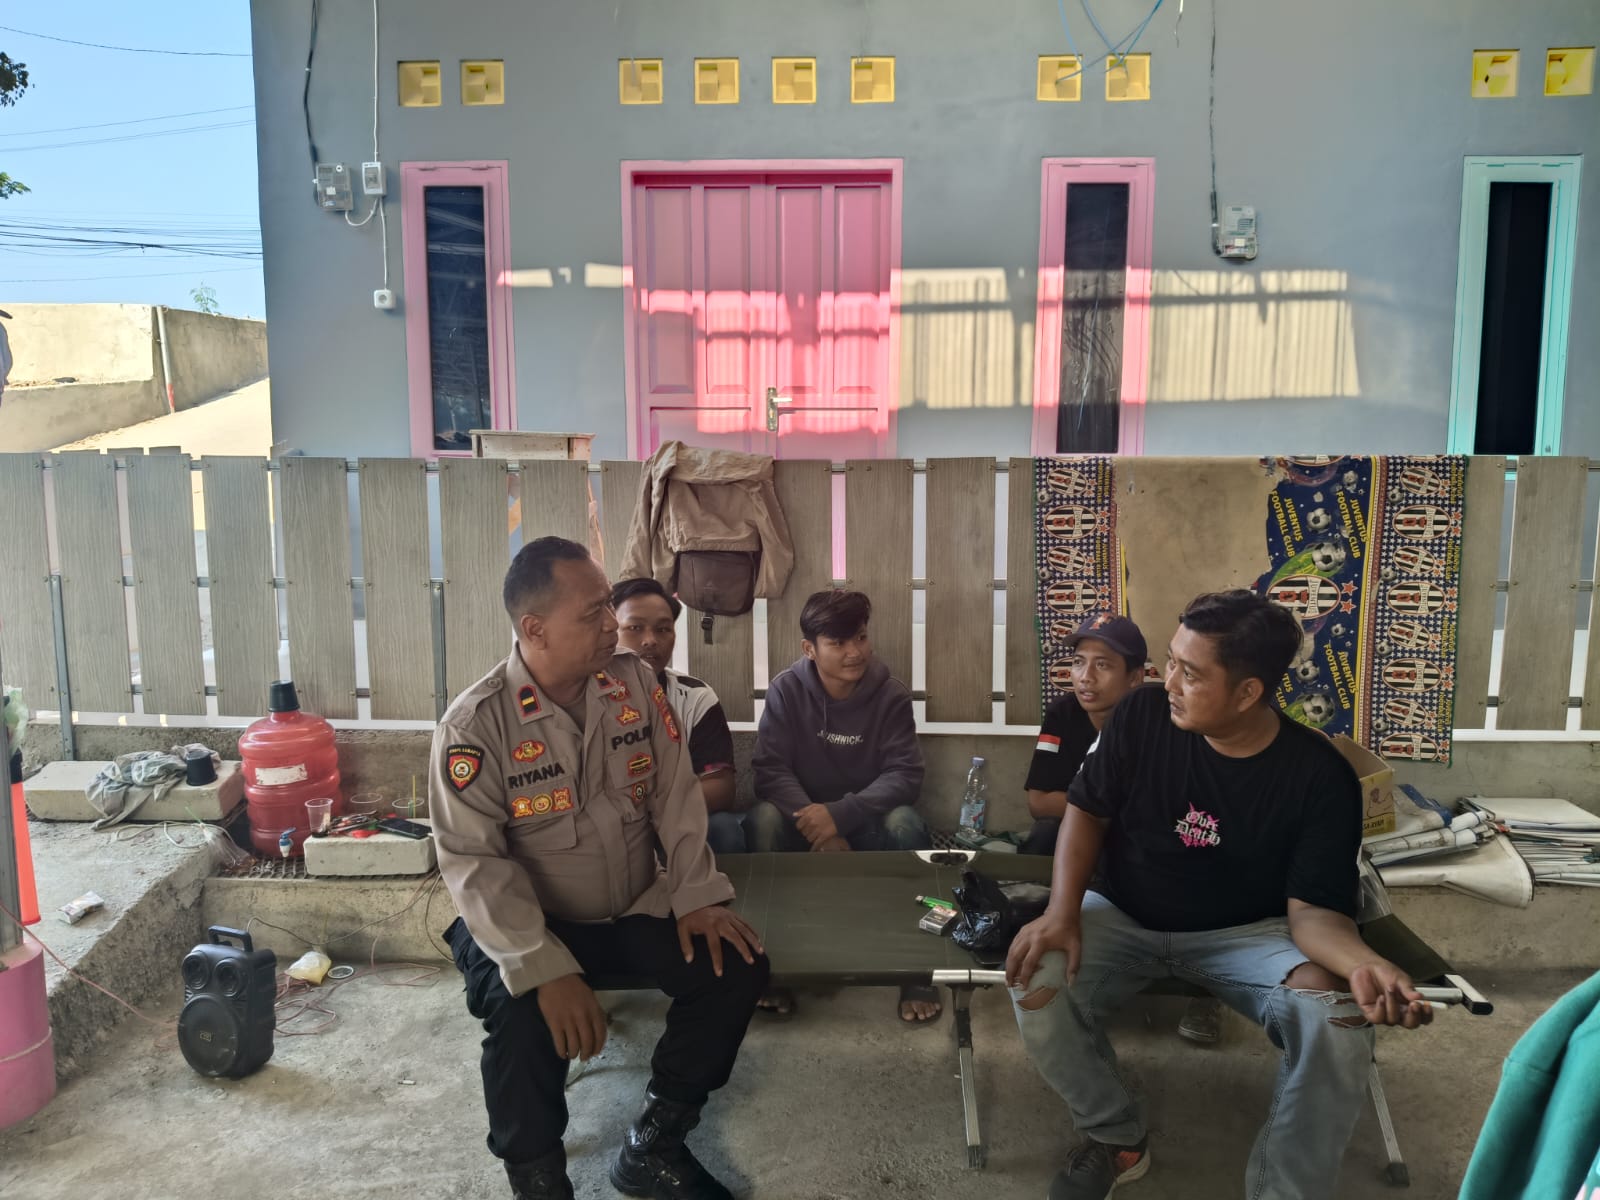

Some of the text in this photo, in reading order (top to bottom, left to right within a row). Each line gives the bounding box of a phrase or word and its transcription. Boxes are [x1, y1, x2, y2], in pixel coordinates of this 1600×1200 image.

[1271, 490, 1296, 558] FOOTBALL CLUB
[1284, 498, 1303, 541] JUVENTUS
[1336, 491, 1361, 559] FOOTBALL CLUB
[1350, 499, 1368, 543] JUVENTUS
[1323, 644, 1351, 709] FOOTBALL CLUB
[1338, 652, 1358, 694] JUVENTUS
[1275, 687, 1287, 709] LUB
[508, 762, 565, 789] RIYANA
